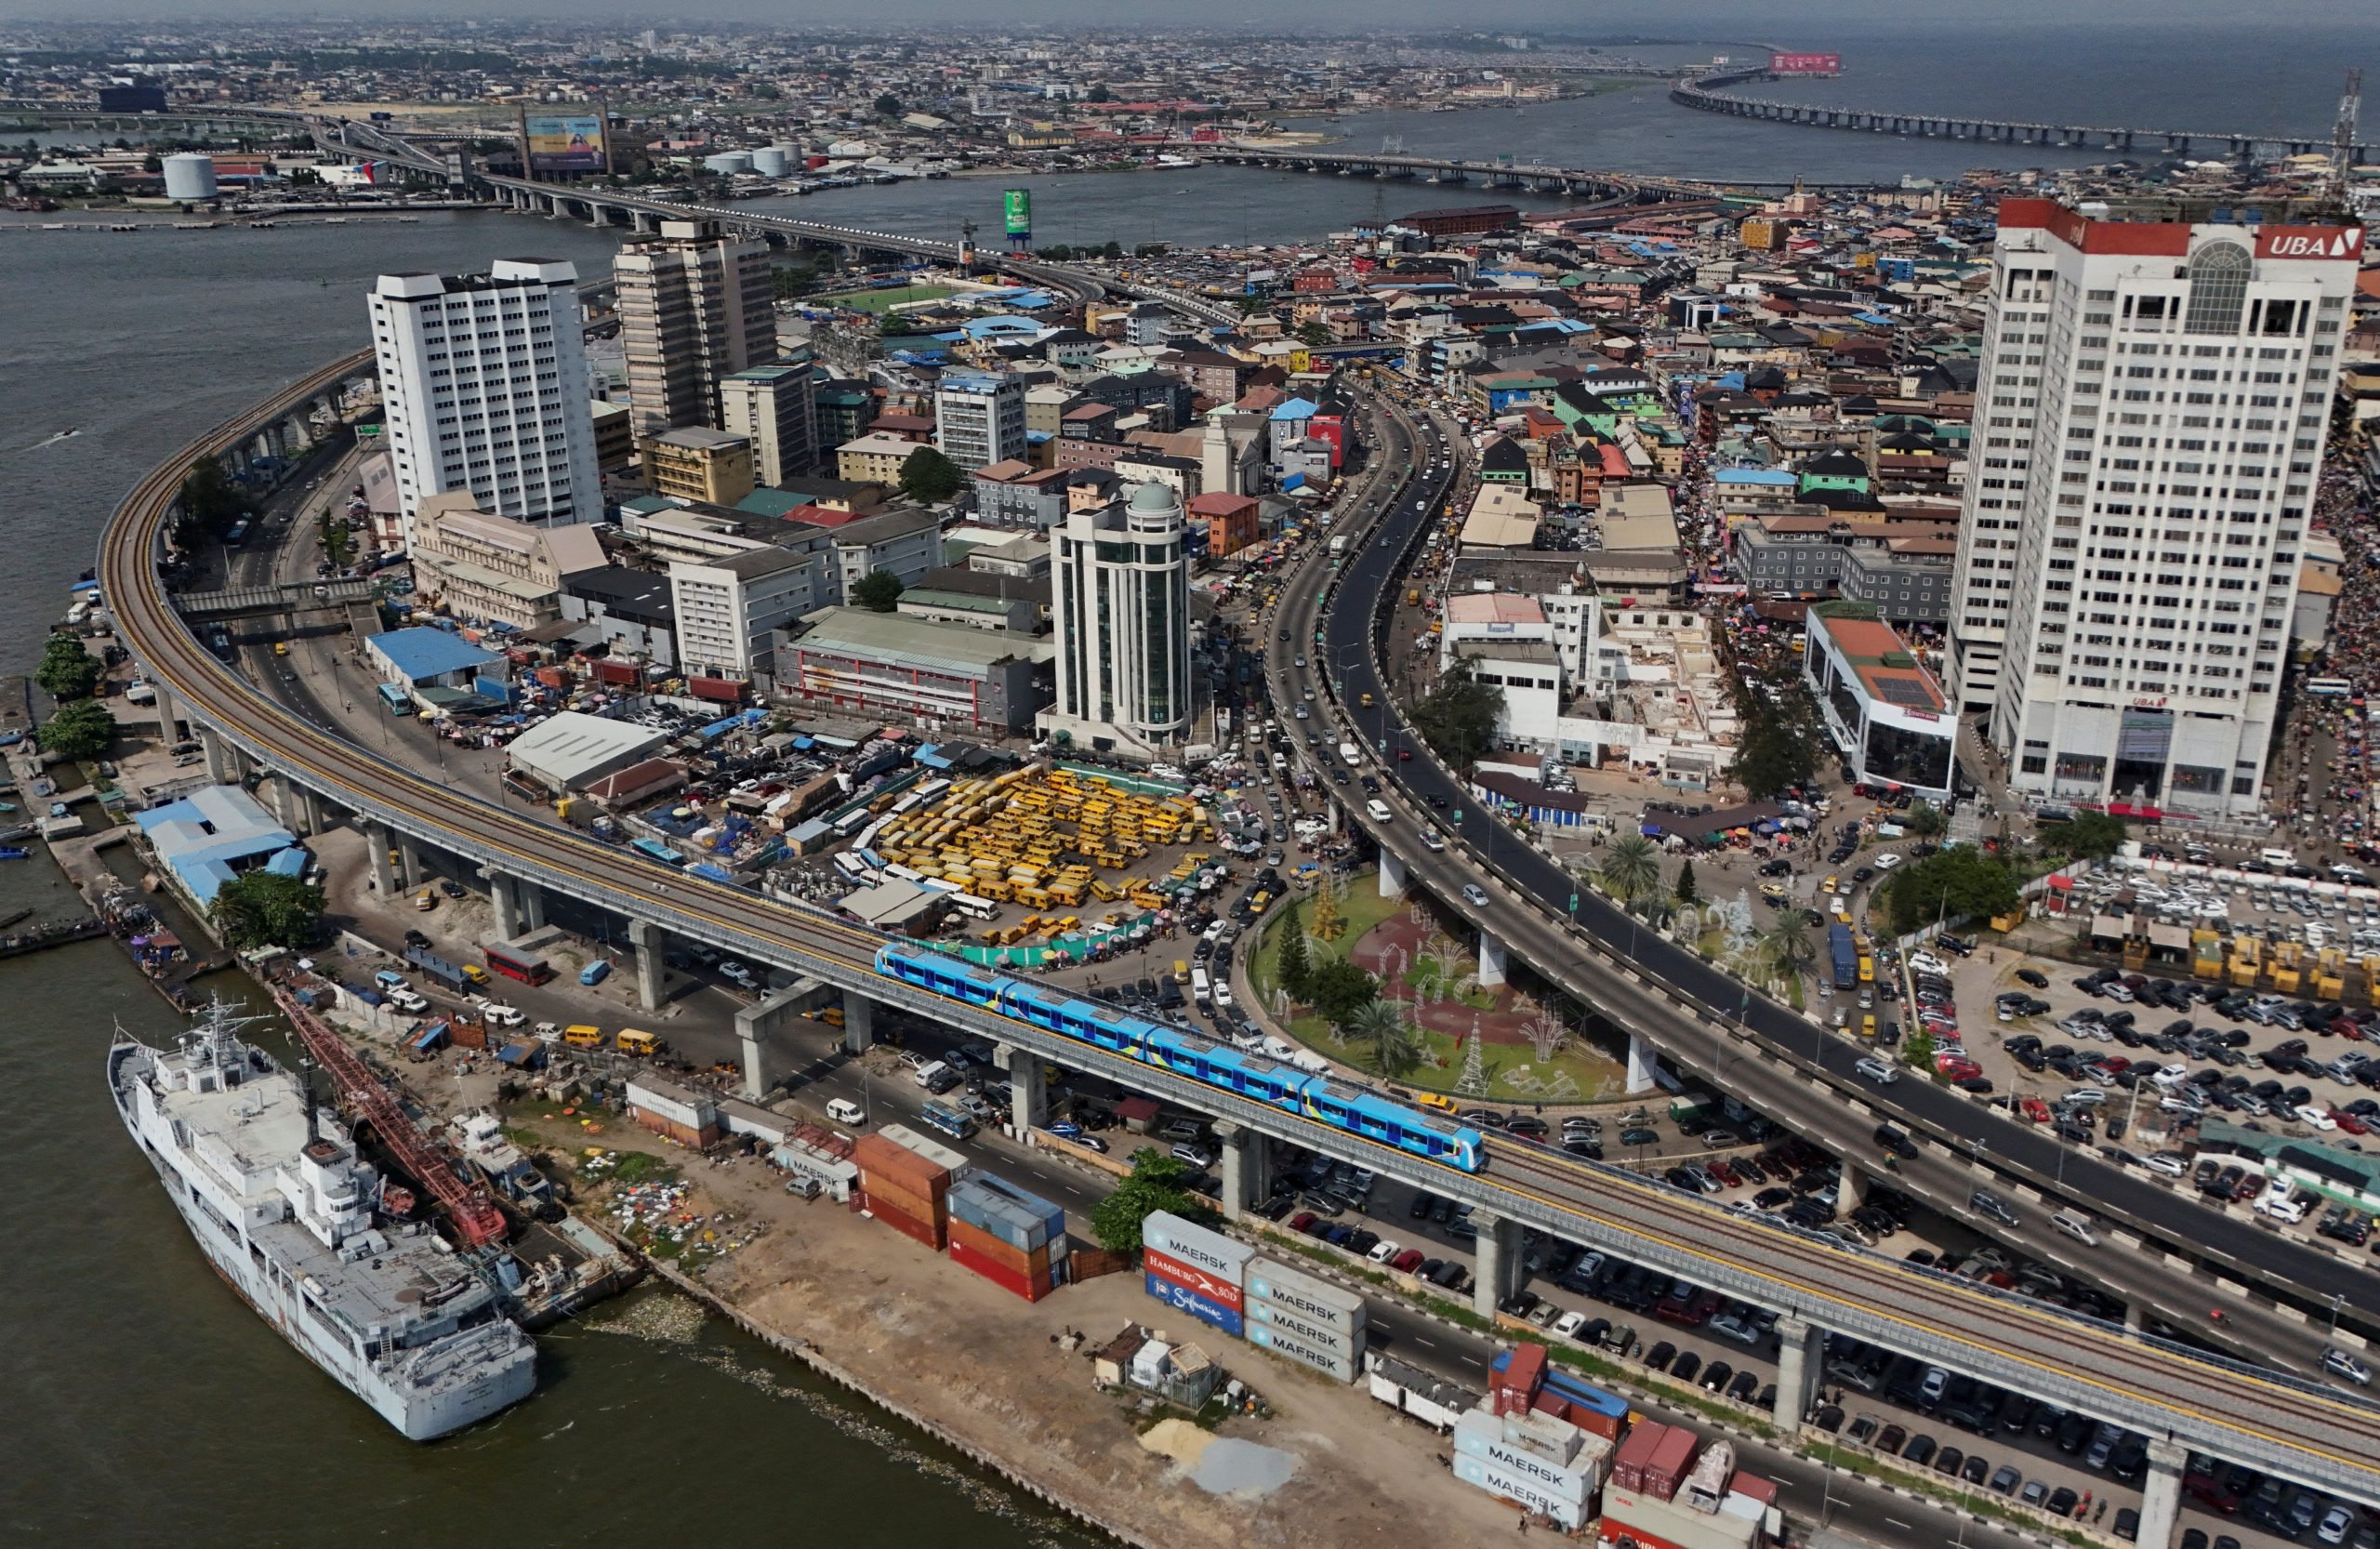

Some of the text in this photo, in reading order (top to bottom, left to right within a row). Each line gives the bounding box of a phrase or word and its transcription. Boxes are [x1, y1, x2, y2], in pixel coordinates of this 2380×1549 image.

[2270, 236, 2324, 256] UBA
[2133, 696, 2155, 707] UBA
[794, 1160, 838, 1187] MAERSK
[1149, 1255, 1196, 1283] HAMBURG
[1170, 1238, 1228, 1273] MAERSK
[1173, 1287, 1223, 1320] Safmarine
[1273, 1288, 1337, 1323] MAERSK
[1274, 1313, 1338, 1348] MAERSK
[1488, 1445, 1564, 1488] MAERSK
[1488, 1473, 1562, 1516] MAERSK
